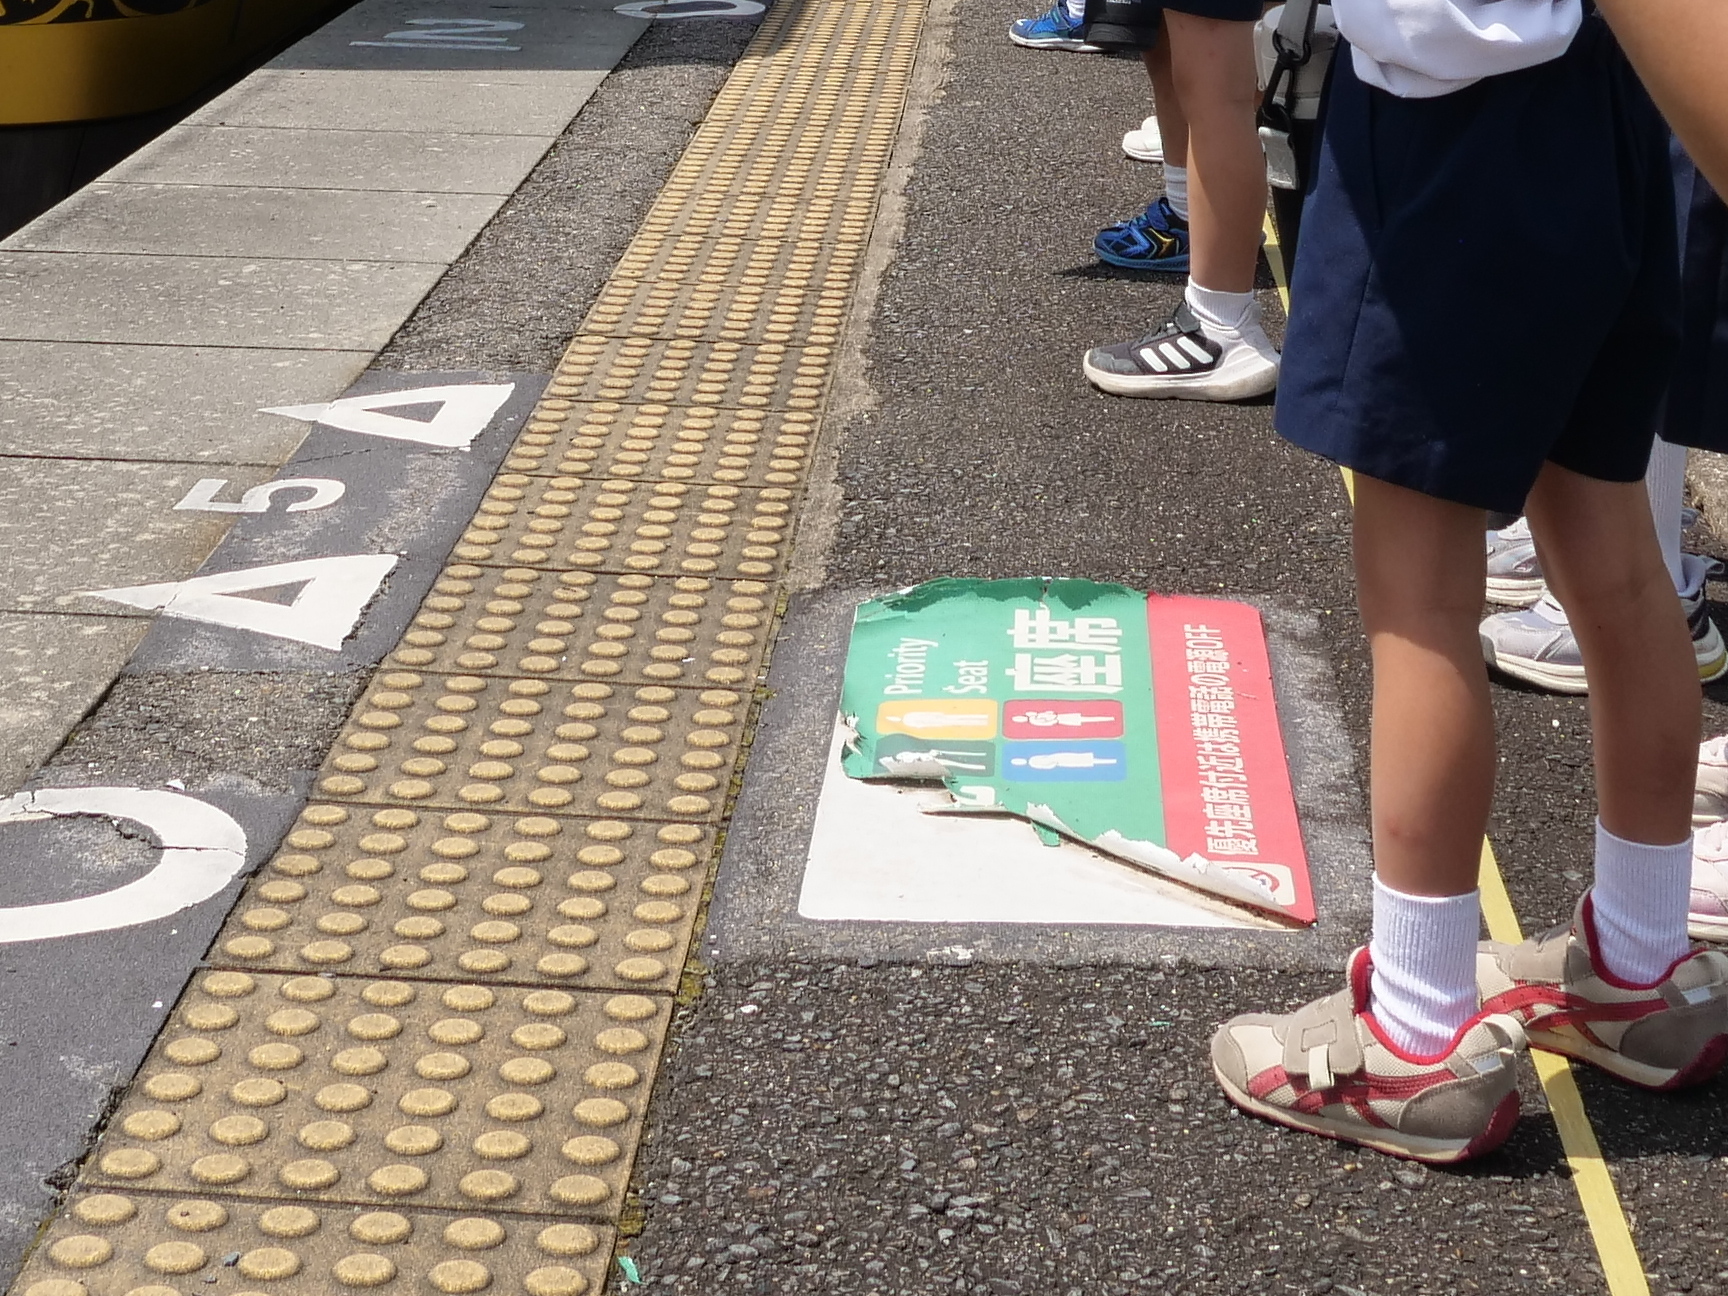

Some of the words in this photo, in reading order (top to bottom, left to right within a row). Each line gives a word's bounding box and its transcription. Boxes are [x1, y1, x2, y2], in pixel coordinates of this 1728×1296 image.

[883, 636, 939, 696] Priority
[946, 658, 990, 695] Seat
[1005, 607, 1124, 694] 座席
[1184, 622, 1259, 856] 優先座席付近は携帯電話の電源OFF
